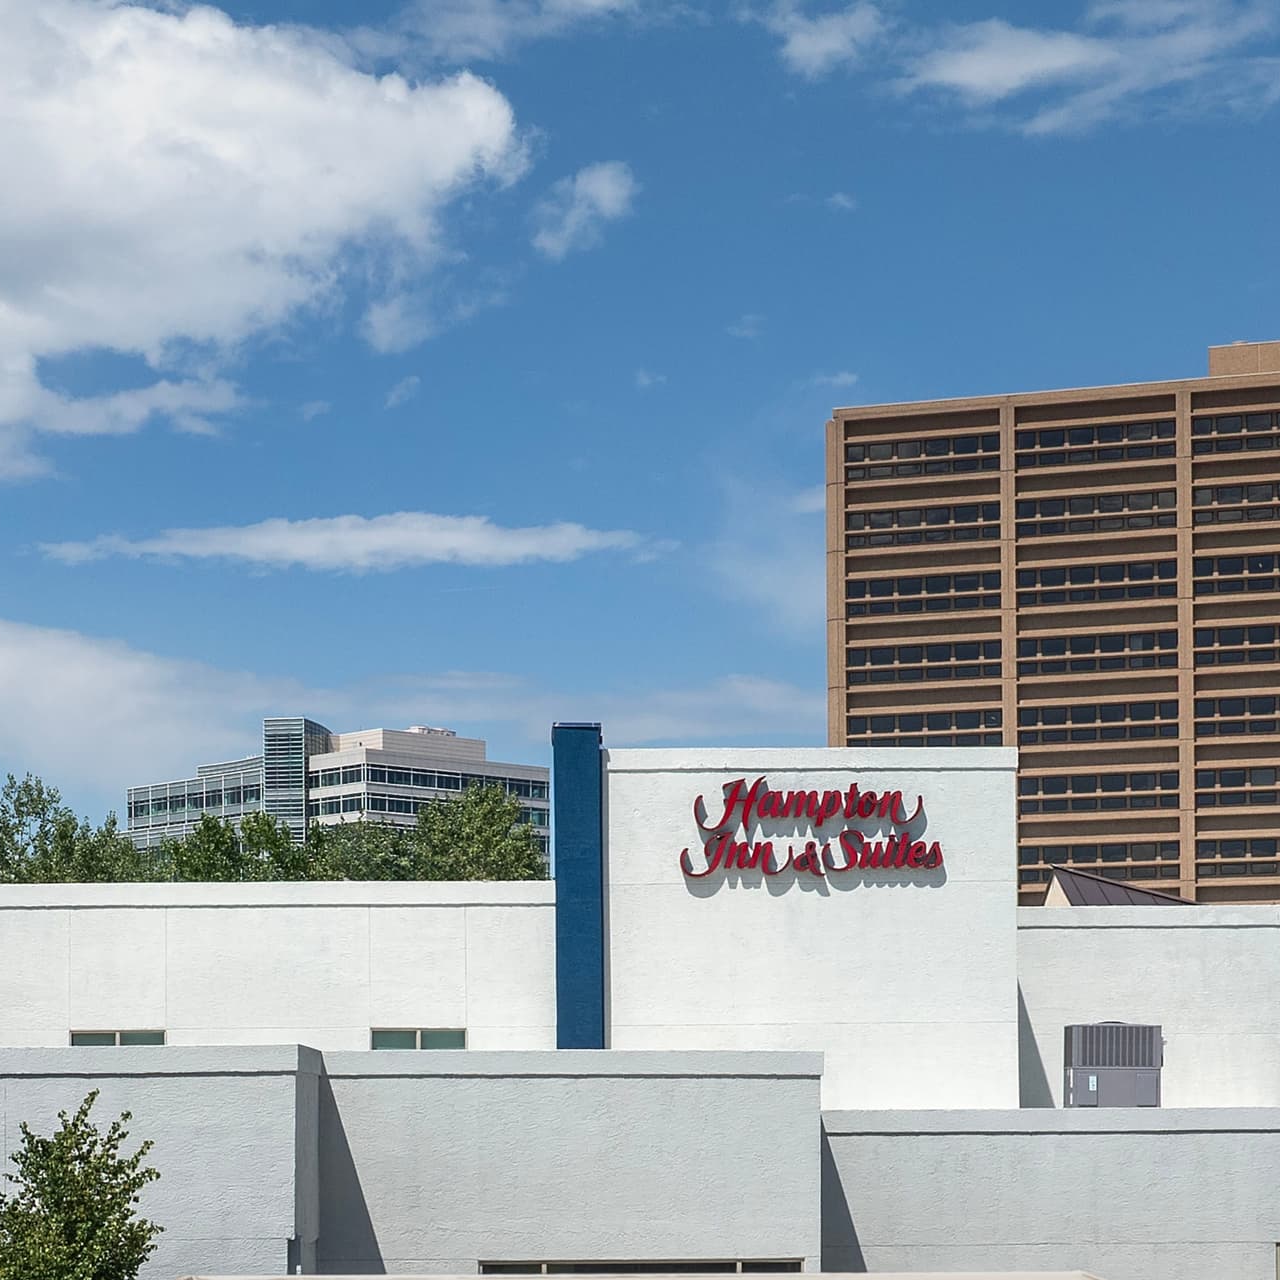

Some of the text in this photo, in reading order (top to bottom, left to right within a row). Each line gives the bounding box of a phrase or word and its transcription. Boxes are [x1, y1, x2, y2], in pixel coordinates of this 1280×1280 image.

[694, 776, 923, 831] Hampton
[680, 830, 943, 877] Inn & Suites
